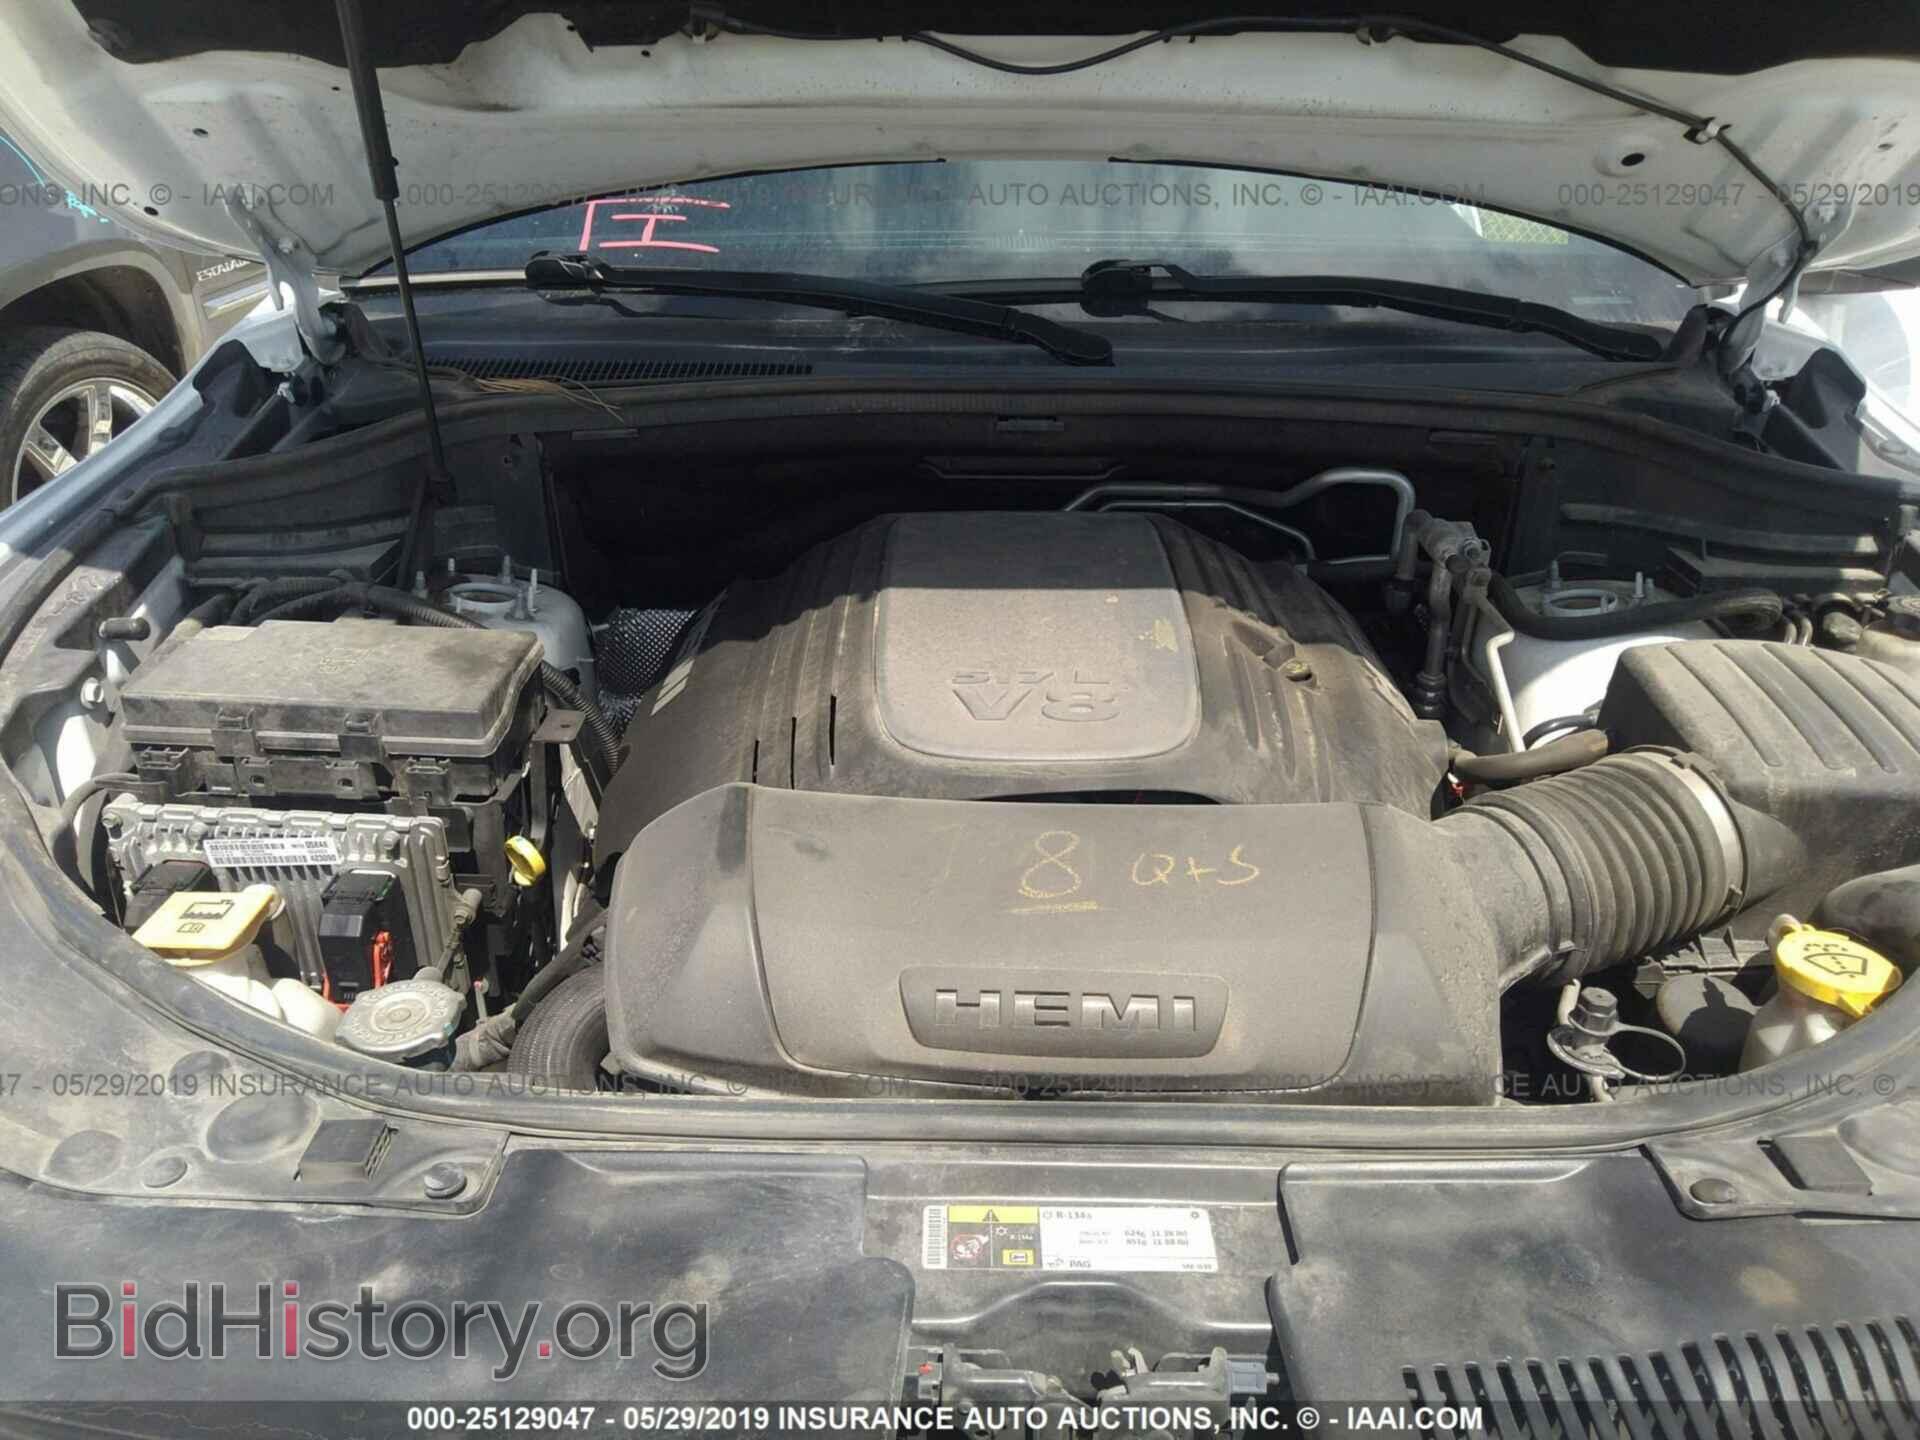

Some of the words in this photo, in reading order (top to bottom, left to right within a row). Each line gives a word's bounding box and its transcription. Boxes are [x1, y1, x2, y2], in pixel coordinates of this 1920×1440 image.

[952, 688, 1120, 722] V8
[1018, 830, 1082, 899] 8
[935, 988, 1196, 1031] HEMI
